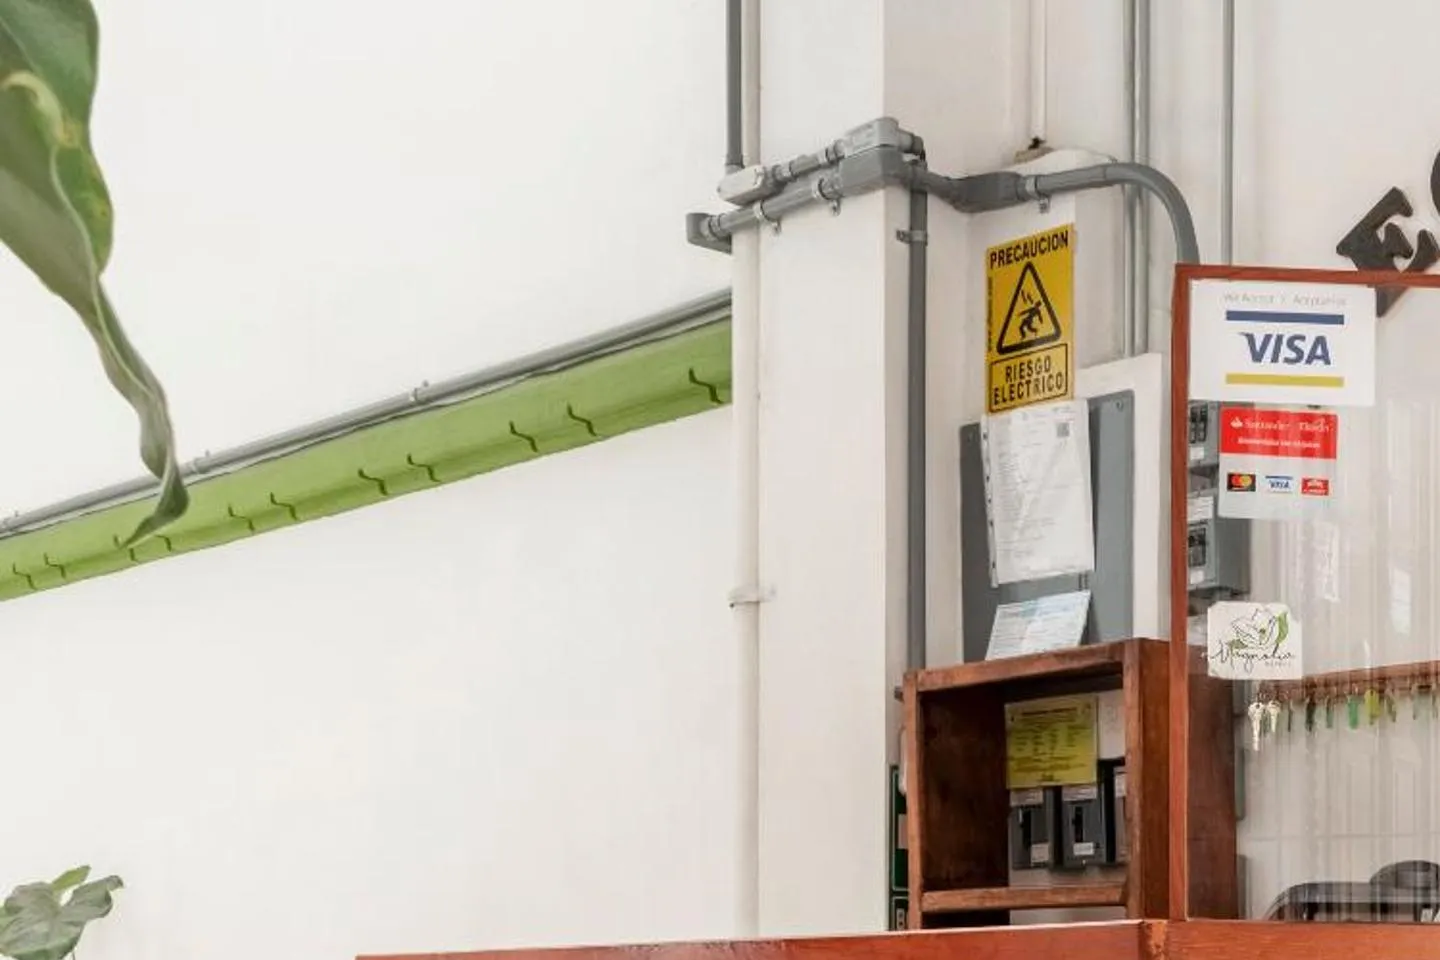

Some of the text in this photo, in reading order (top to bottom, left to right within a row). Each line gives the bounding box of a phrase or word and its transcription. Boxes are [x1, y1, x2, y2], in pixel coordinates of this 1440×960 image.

[990, 230, 1069, 270] PRECAUCION
[1239, 332, 1331, 366] VISA
[1005, 355, 1051, 384] RIESGO
[993, 371, 1063, 407] ELECTRICO
